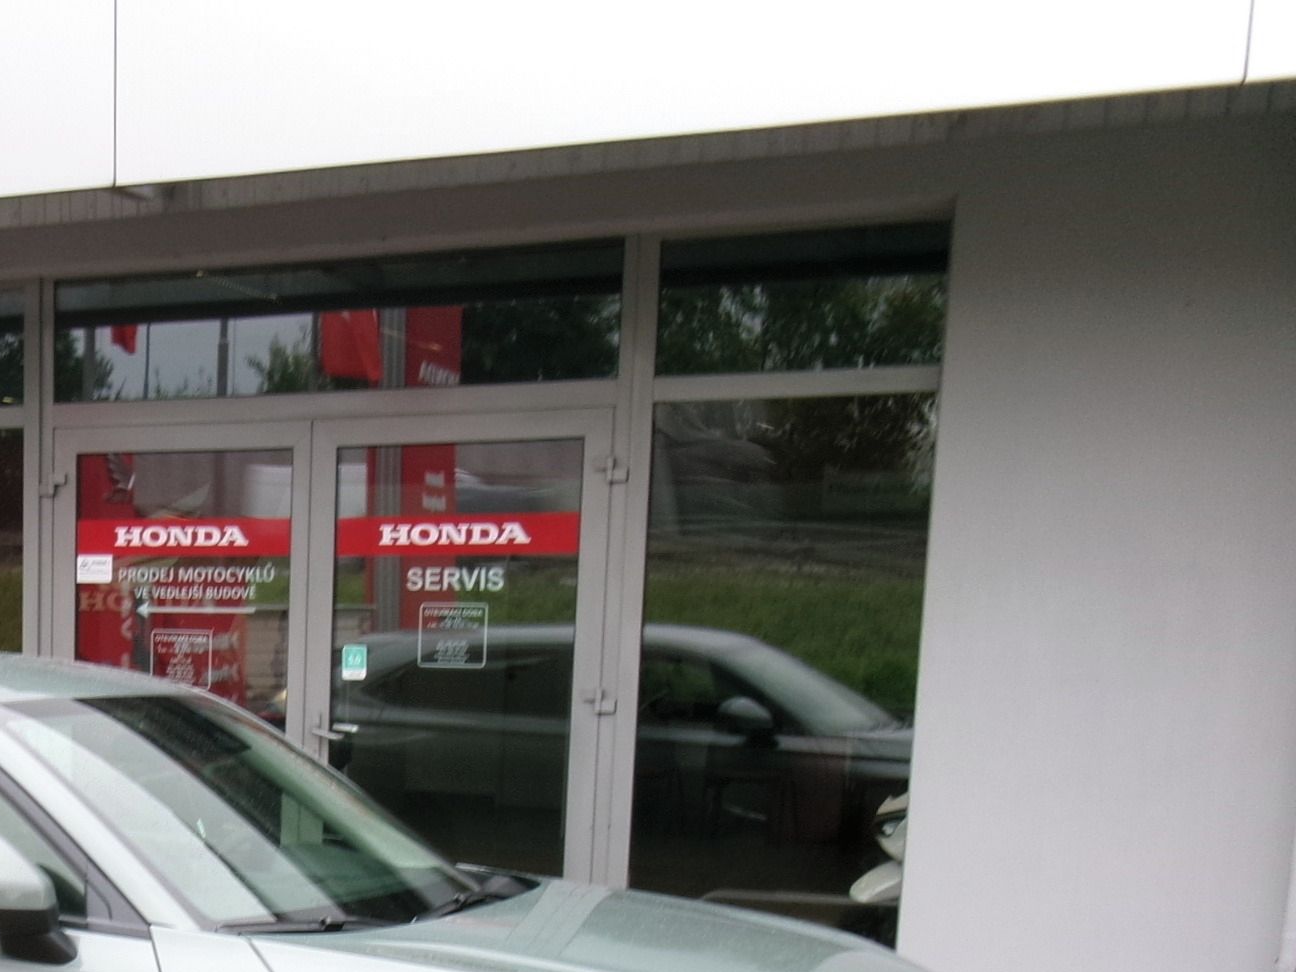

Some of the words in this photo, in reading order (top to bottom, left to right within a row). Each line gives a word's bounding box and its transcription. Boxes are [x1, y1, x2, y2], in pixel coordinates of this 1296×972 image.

[114, 525, 249, 548] HONDA
[378, 521, 531, 547] HONDA
[118, 566, 173, 584] PRODEJ
[178, 562, 275, 584] MOTOCYKLŮ
[406, 566, 505, 592] SERVIS
